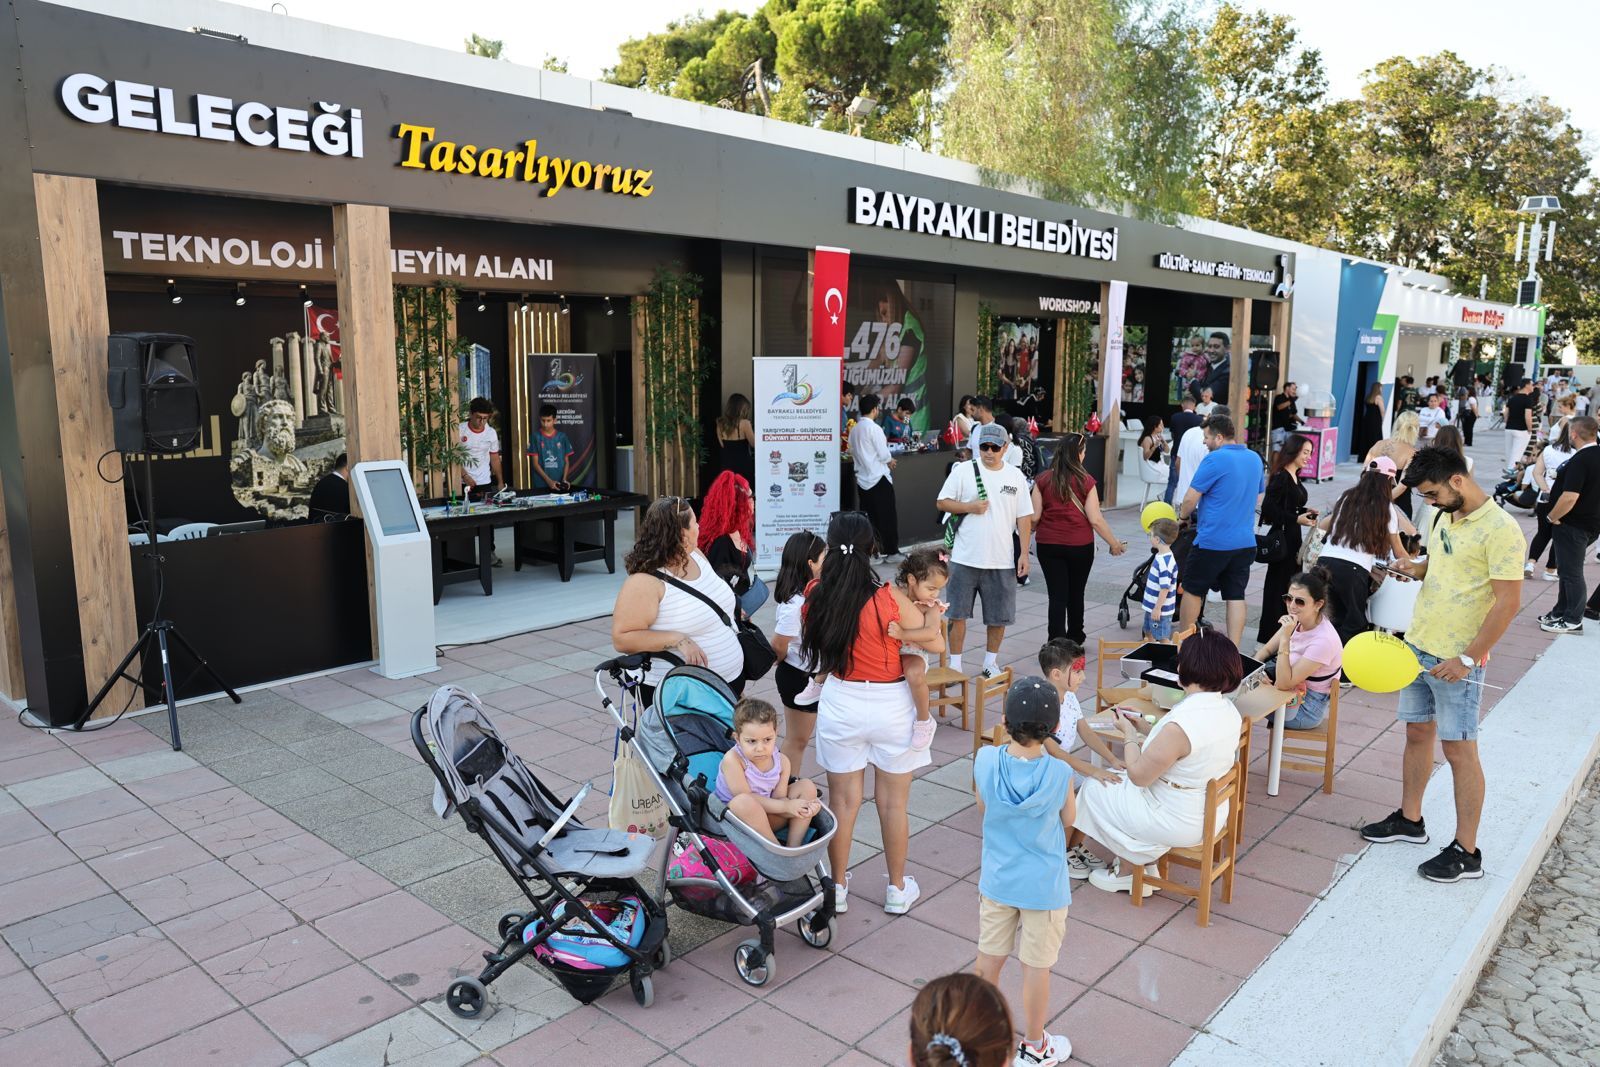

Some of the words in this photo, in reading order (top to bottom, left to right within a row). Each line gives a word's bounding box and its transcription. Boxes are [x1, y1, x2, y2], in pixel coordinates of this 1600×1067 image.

[62, 73, 364, 158] GELECEĞİ
[398, 123, 654, 197] Tasarlıyoruz
[855, 186, 995, 243] BAYRAKLI
[1001, 214, 1119, 261] BELEDİYESİ
[112, 230, 323, 269] TEKNOLOJİ
[334, 246, 467, 277] EYİM
[474, 255, 553, 280] ALANI
[1039, 296, 1091, 314] WORKSHOP
[843, 321, 902, 360] .476
